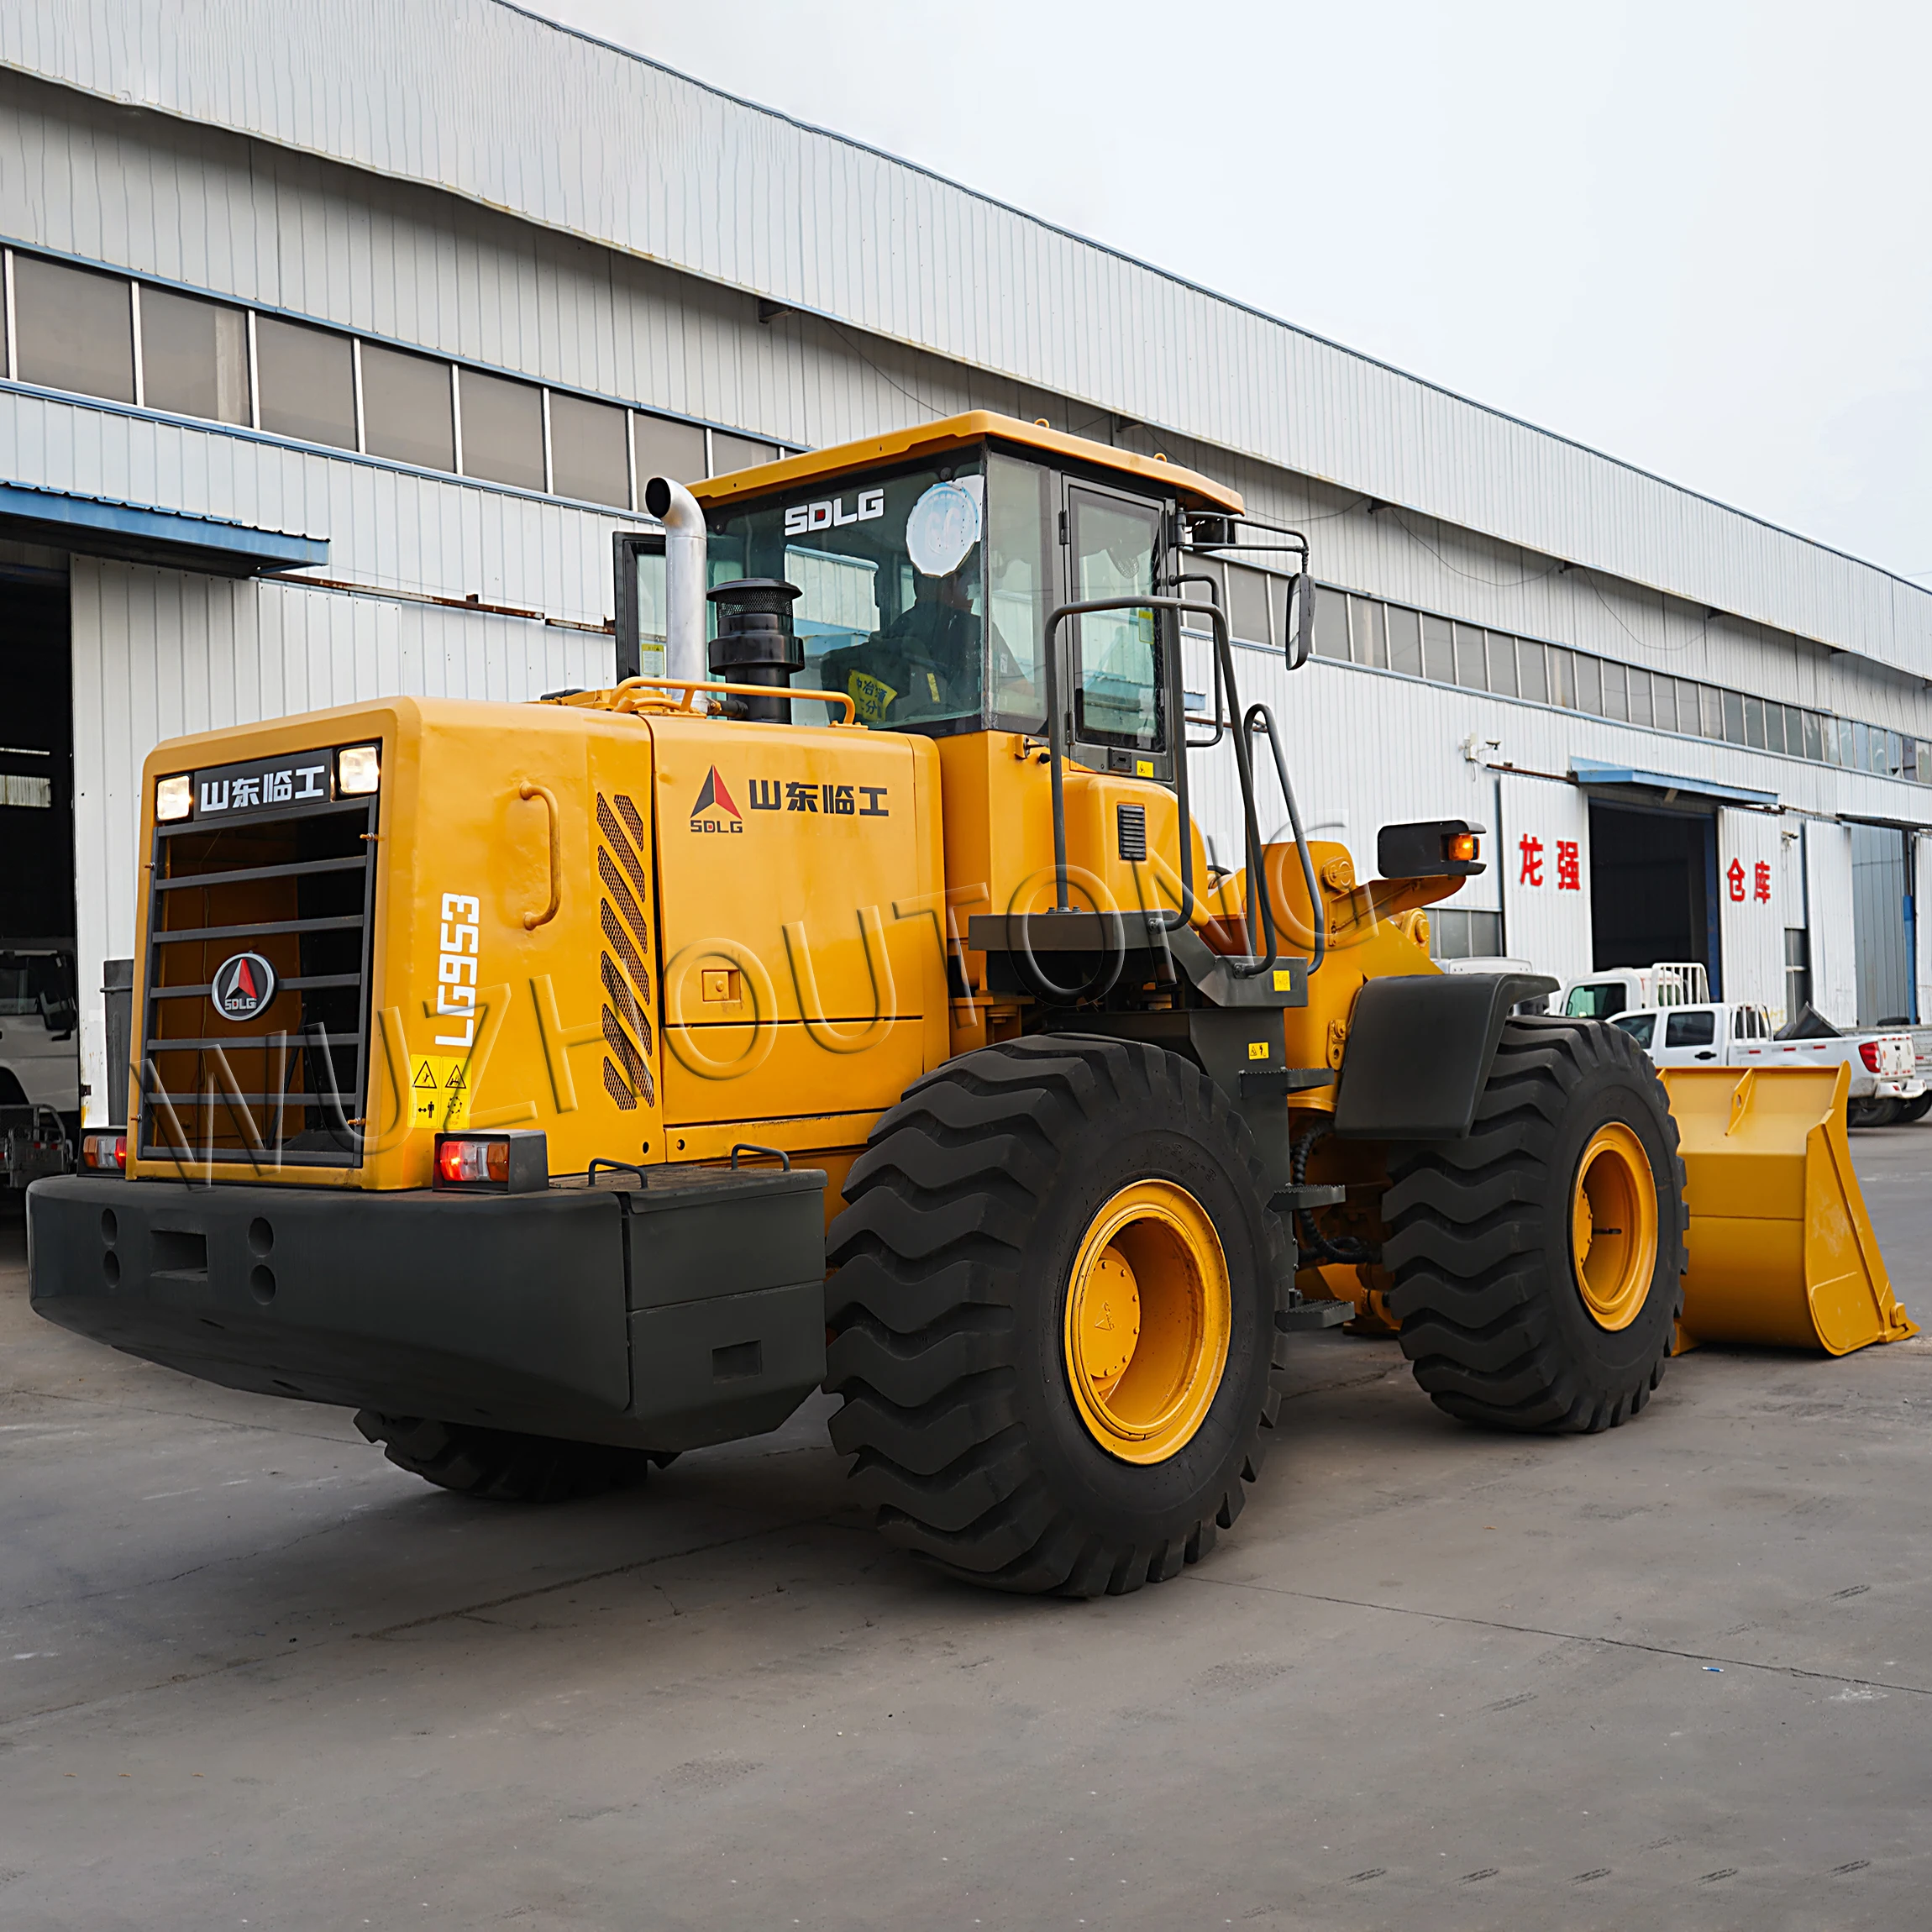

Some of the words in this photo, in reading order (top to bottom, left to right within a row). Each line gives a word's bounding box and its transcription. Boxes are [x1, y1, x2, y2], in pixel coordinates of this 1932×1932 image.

[785, 488, 884, 536] SDLG
[200, 765, 325, 811] 山东临工
[748, 780, 890, 816] 山东临工
[690, 820, 743, 833] SDLG
[1519, 833, 1581, 890] 龙强
[1727, 858, 1771, 904] 仓库
[434, 892, 480, 1047] LG953
[224, 998, 257, 1011] SDLG
